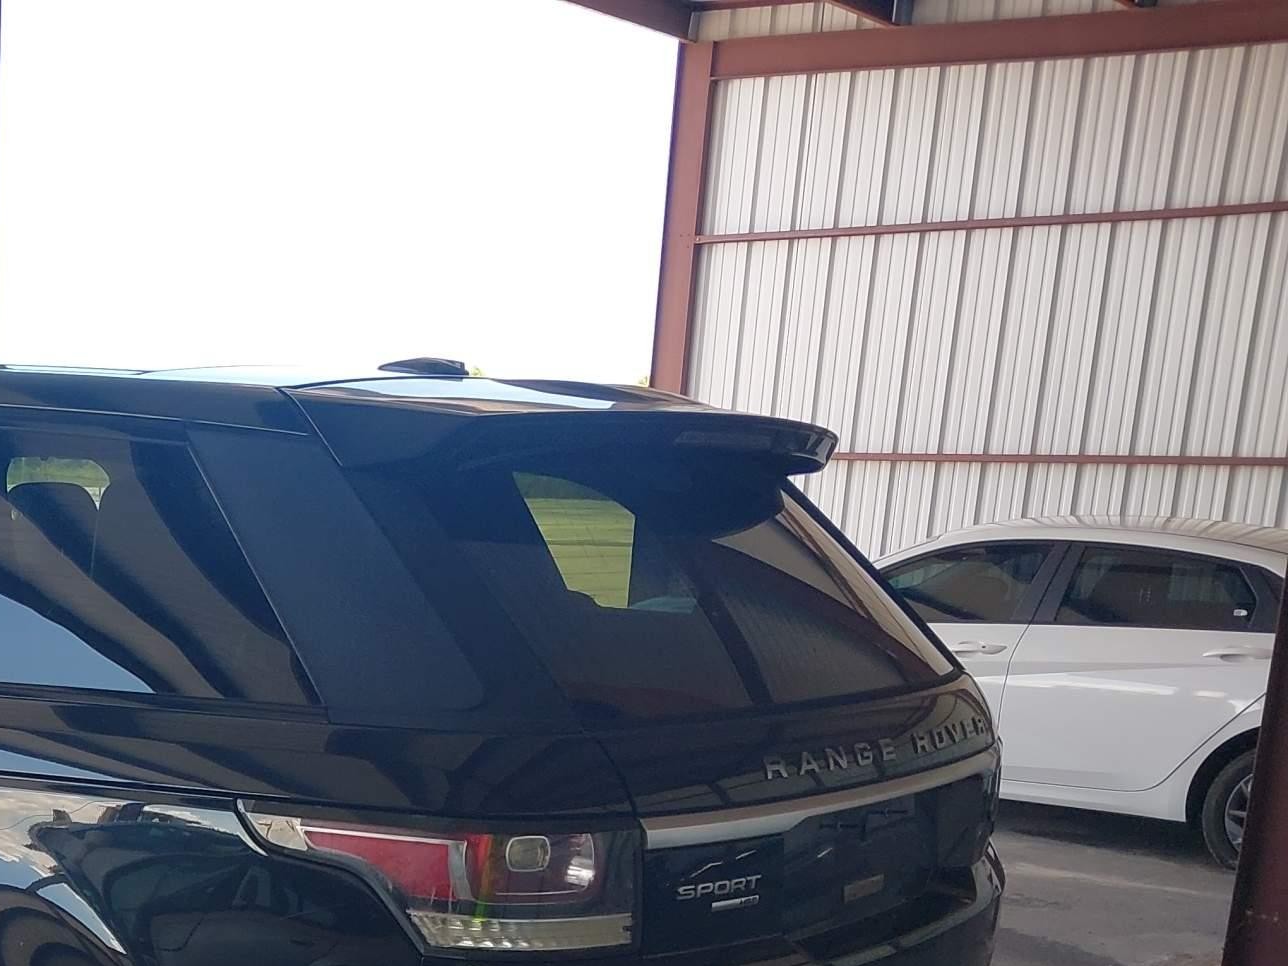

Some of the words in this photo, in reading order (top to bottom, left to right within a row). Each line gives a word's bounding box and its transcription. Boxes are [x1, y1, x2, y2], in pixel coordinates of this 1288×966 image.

[763, 737, 897, 780] RANGE
[912, 716, 985, 754] ROVER
[677, 874, 762, 900] SPORT
